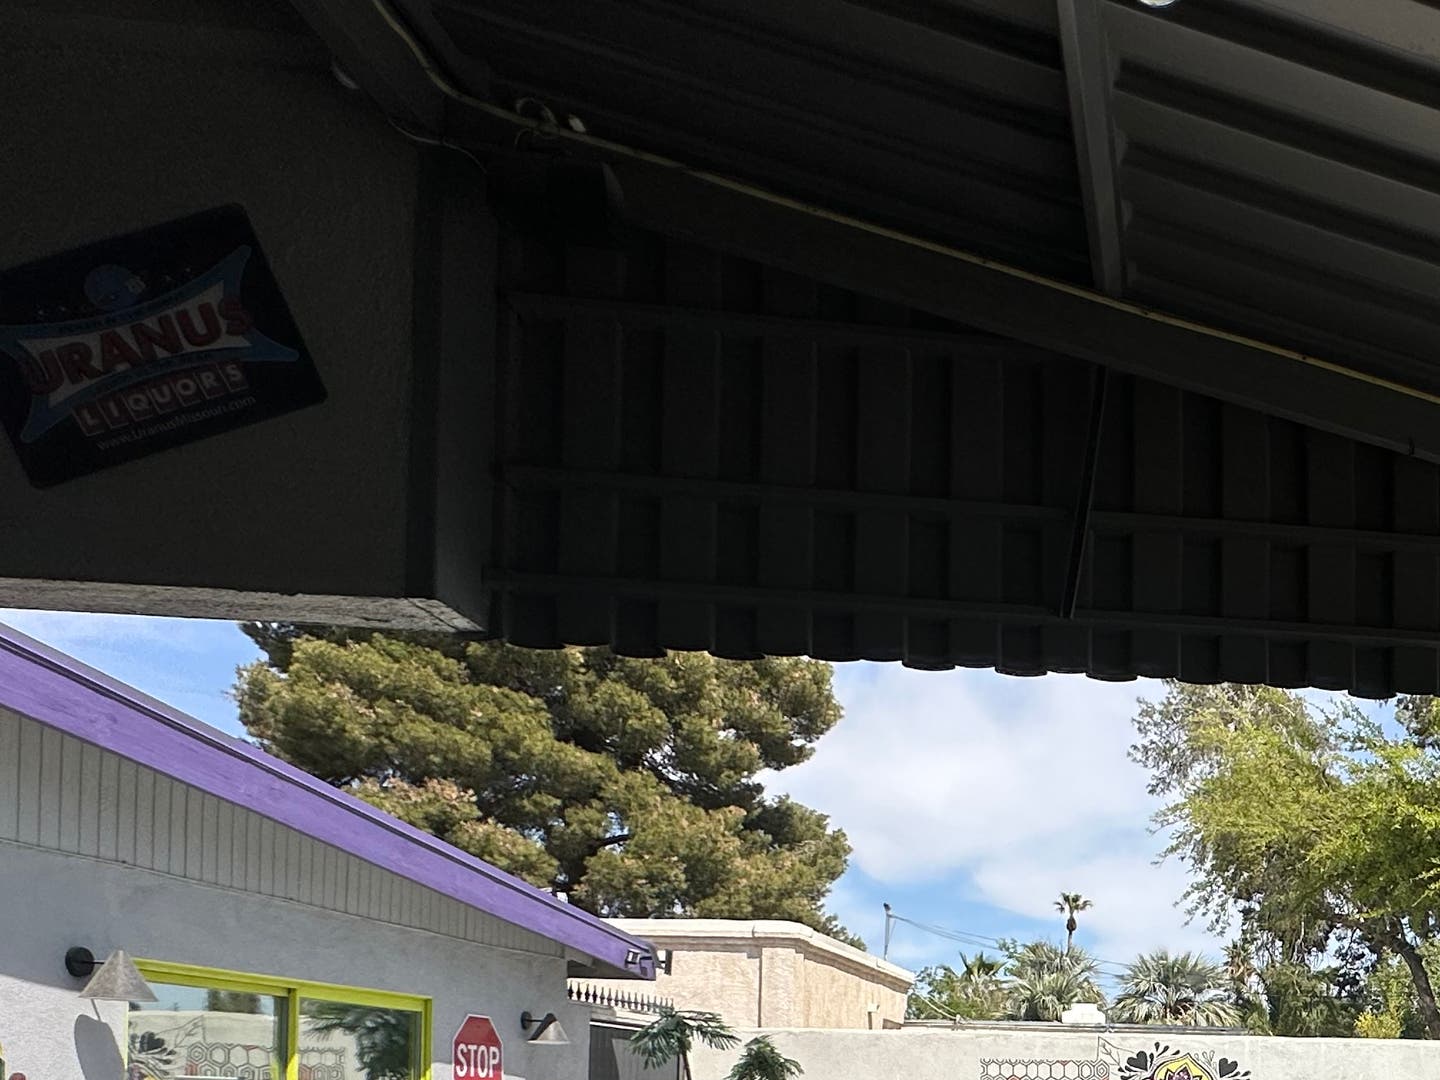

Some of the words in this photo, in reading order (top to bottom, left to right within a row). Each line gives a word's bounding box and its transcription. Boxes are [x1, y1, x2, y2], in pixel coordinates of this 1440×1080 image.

[23, 301, 255, 397] URANUS
[79, 362, 246, 428] LIQUORS
[456, 1043, 500, 1079] STOP
